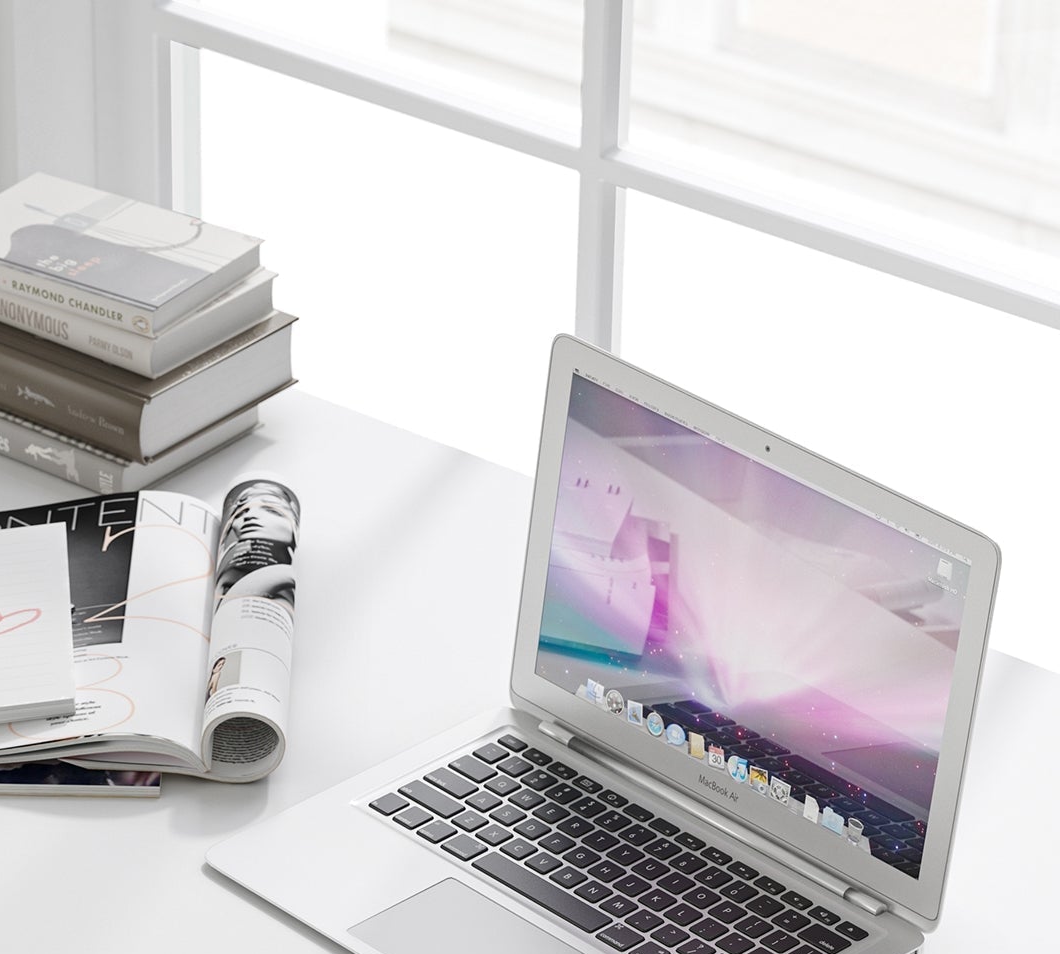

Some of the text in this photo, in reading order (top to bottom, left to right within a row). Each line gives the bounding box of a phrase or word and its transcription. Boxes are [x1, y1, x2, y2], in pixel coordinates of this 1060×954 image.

[12, 280, 65, 304] RAYMOND
[69, 298, 124, 322] CHANDLER
[711, 754, 722, 765] 30
[698, 774, 739, 802] MacBook Air
